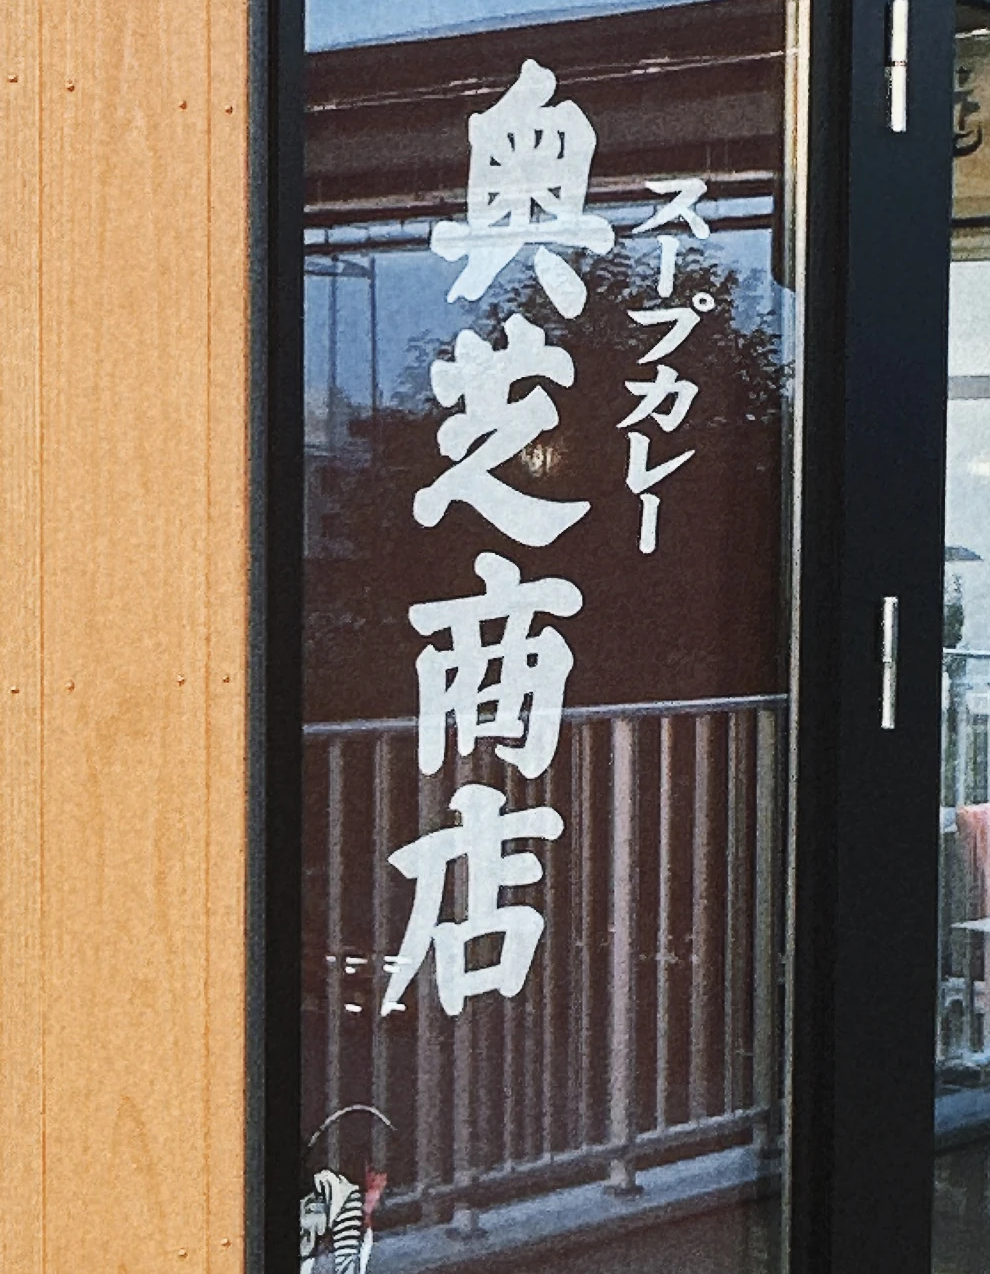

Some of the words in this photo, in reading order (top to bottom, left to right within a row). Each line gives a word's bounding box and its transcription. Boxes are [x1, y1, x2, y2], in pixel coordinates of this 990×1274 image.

[381, 59, 615, 1015] 奥芝商店
[616, 178, 714, 554] スープカレー
